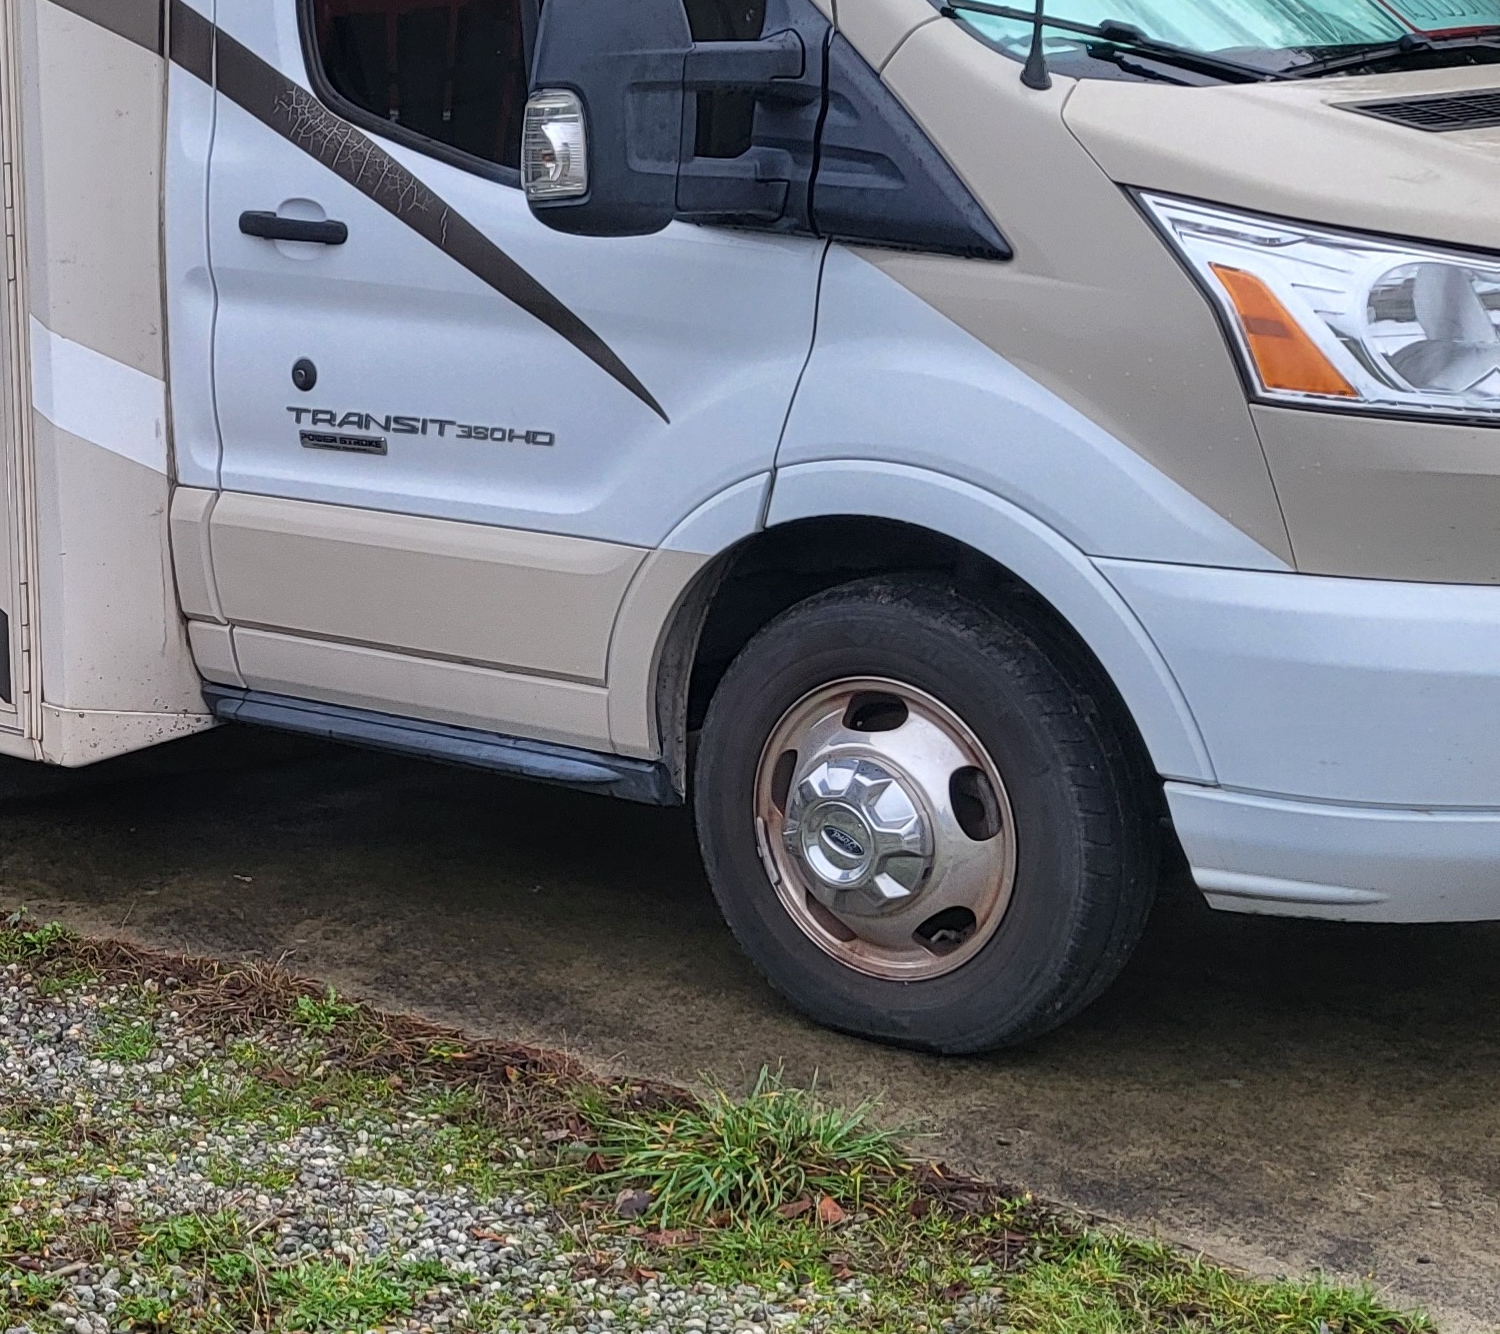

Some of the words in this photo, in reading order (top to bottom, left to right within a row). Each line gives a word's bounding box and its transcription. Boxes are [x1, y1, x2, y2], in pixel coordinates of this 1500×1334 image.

[286, 406, 456, 437] TRANSIT
[455, 423, 555, 447] 350HD
[300, 432, 338, 444] POWER
[339, 436, 383, 449] STROKE
[830, 828, 858, 851] Ford
